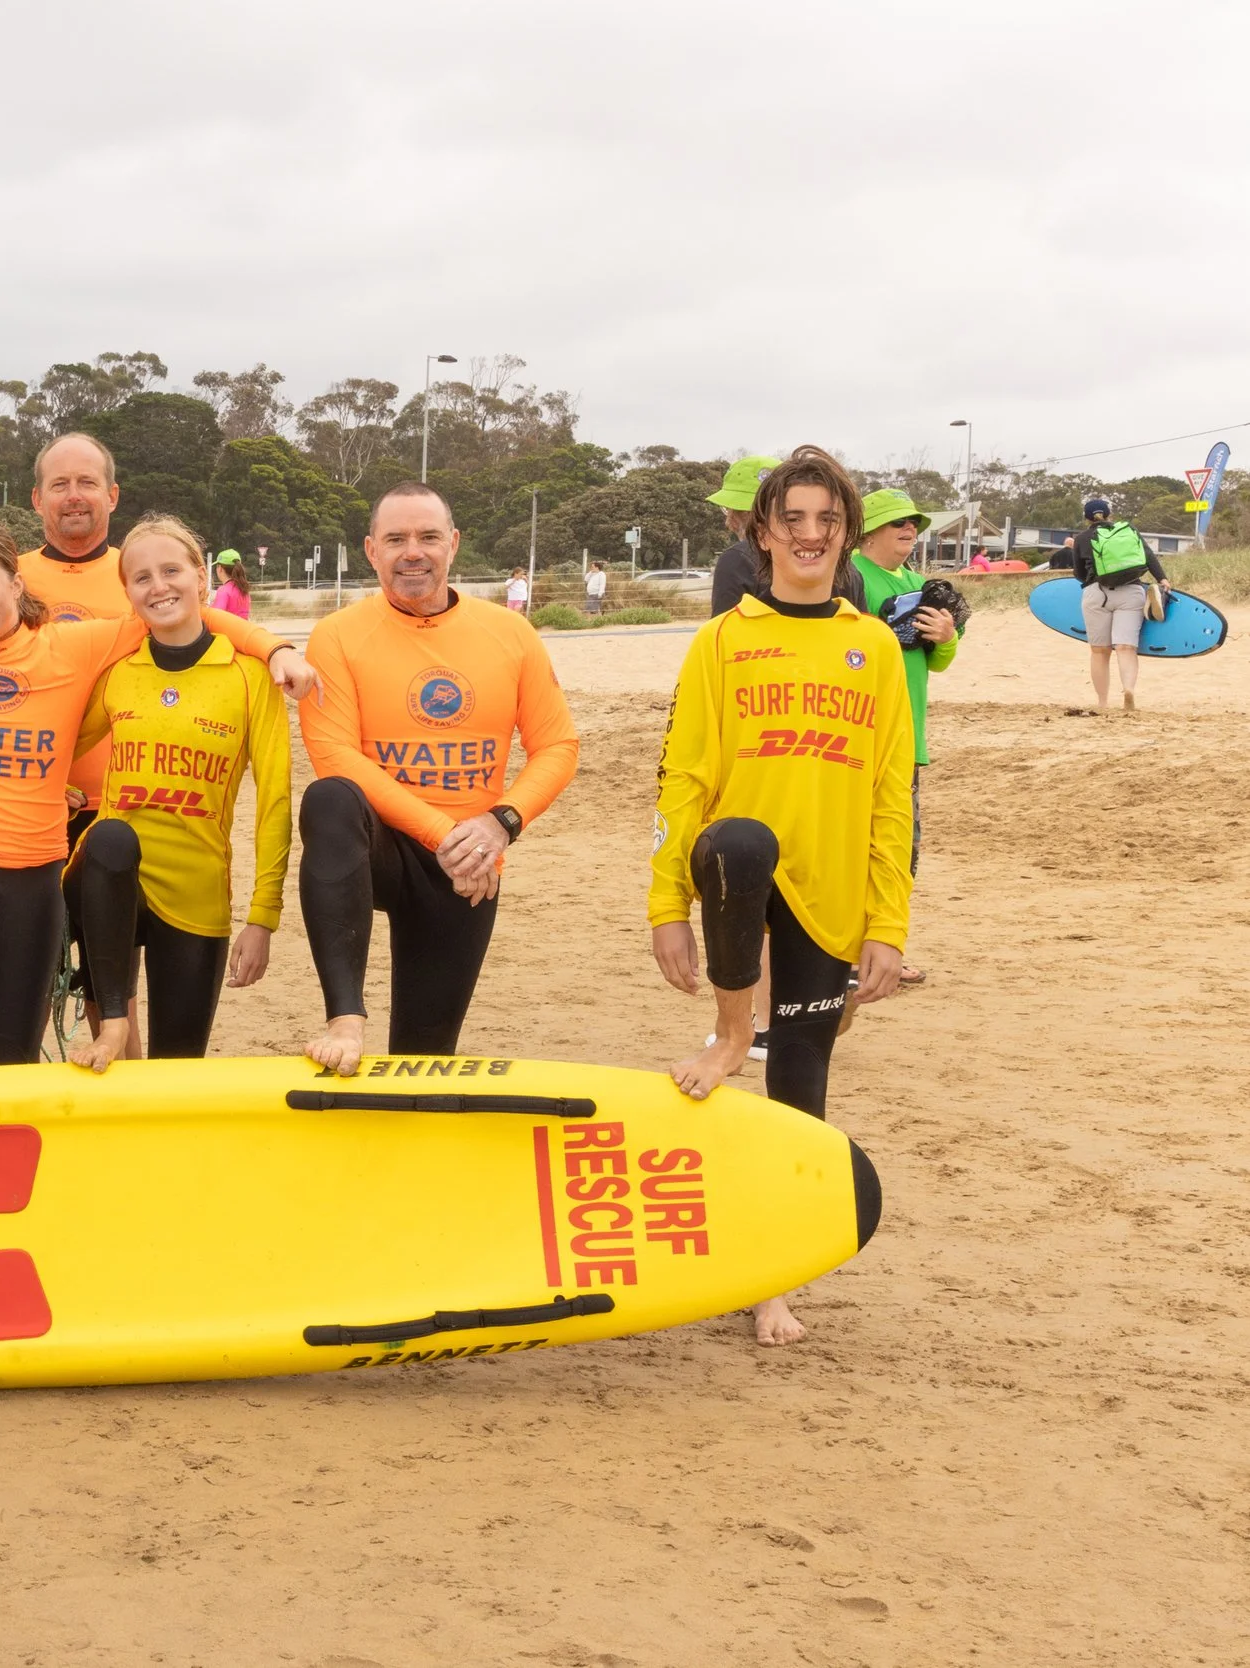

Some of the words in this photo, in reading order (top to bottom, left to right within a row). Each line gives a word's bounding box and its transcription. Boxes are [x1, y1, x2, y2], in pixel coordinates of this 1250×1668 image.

[733, 647, 786, 663] DHL
[420, 669, 460, 681] TORQUAY
[735, 683, 796, 719] SURF
[113, 710, 135, 720] HL
[194, 716, 237, 735] ISUZU
[417, 712, 433, 726] LIFE
[434, 712, 466, 727] SAVING
[201, 727, 228, 738] UTE
[375, 738, 496, 767] WATER
[756, 729, 849, 764] DHL
[110, 741, 148, 773] SURF
[153, 742, 230, 785] RESCUE
[380, 765, 496, 791] AFETY
[116, 785, 210, 818] DHL
[777, 1004, 802, 1016] RIP
[807, 993, 845, 1012] CURL
[314, 1060, 514, 1077] BENNET
[563, 1121, 638, 1288] RESCUE
[638, 1148, 710, 1256] SURF
[341, 1338, 549, 1369] BENNETT
